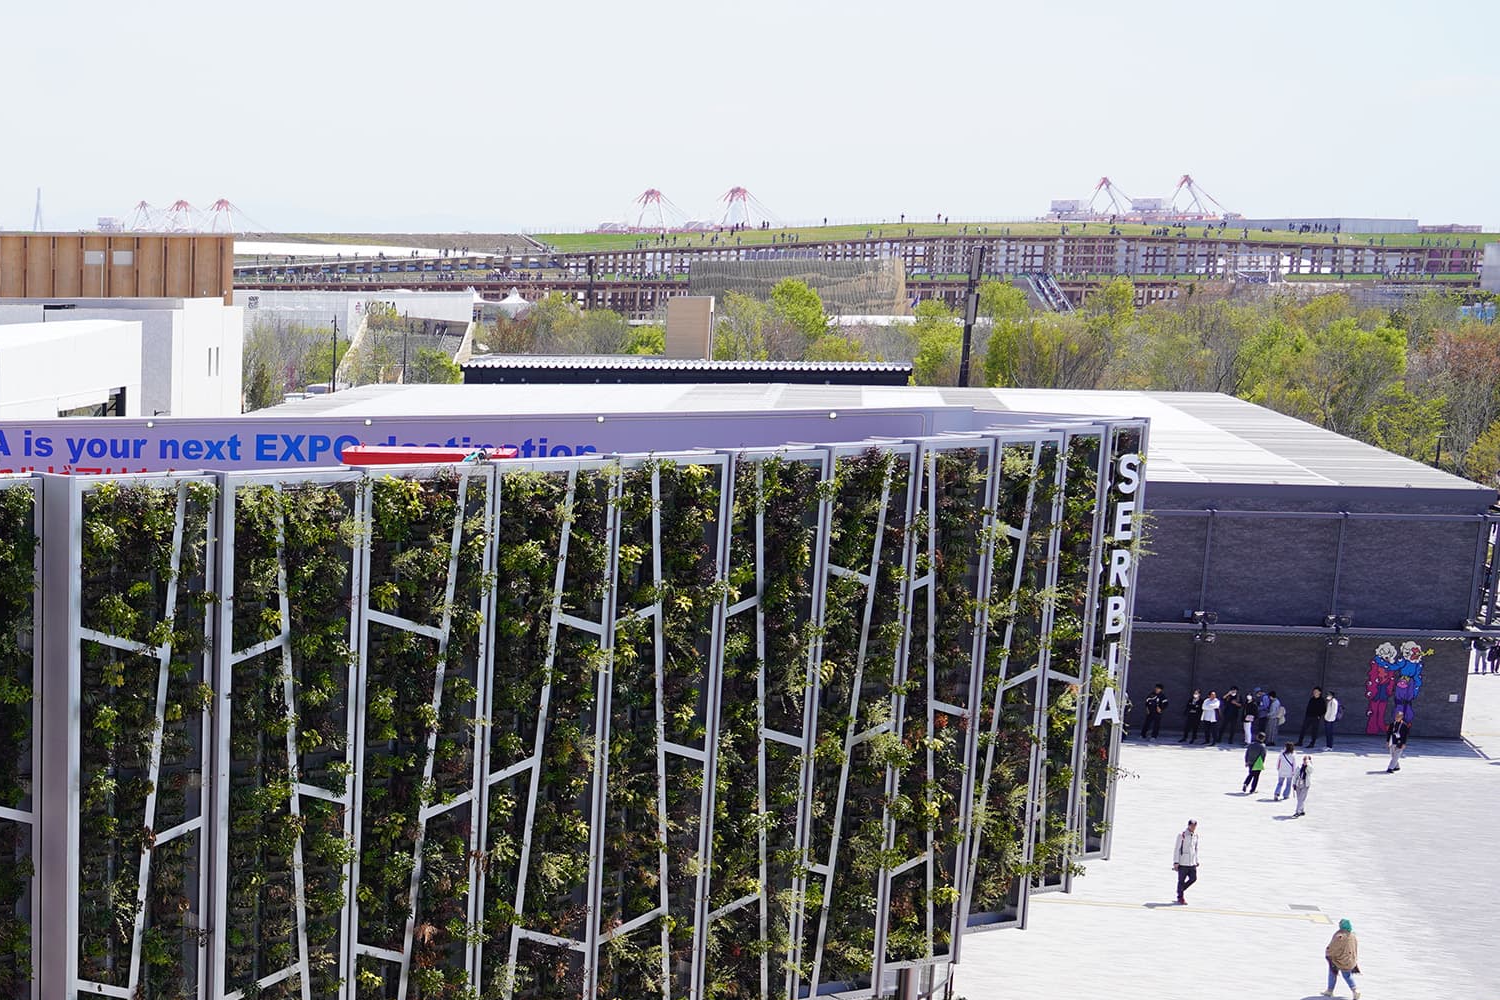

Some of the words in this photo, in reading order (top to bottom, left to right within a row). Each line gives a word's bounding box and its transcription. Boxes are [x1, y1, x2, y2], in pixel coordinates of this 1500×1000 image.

[24, 430, 54, 457] is
[67, 436, 144, 464] your
[159, 433, 242, 461] next
[1094, 453, 1141, 727] SERBIA
